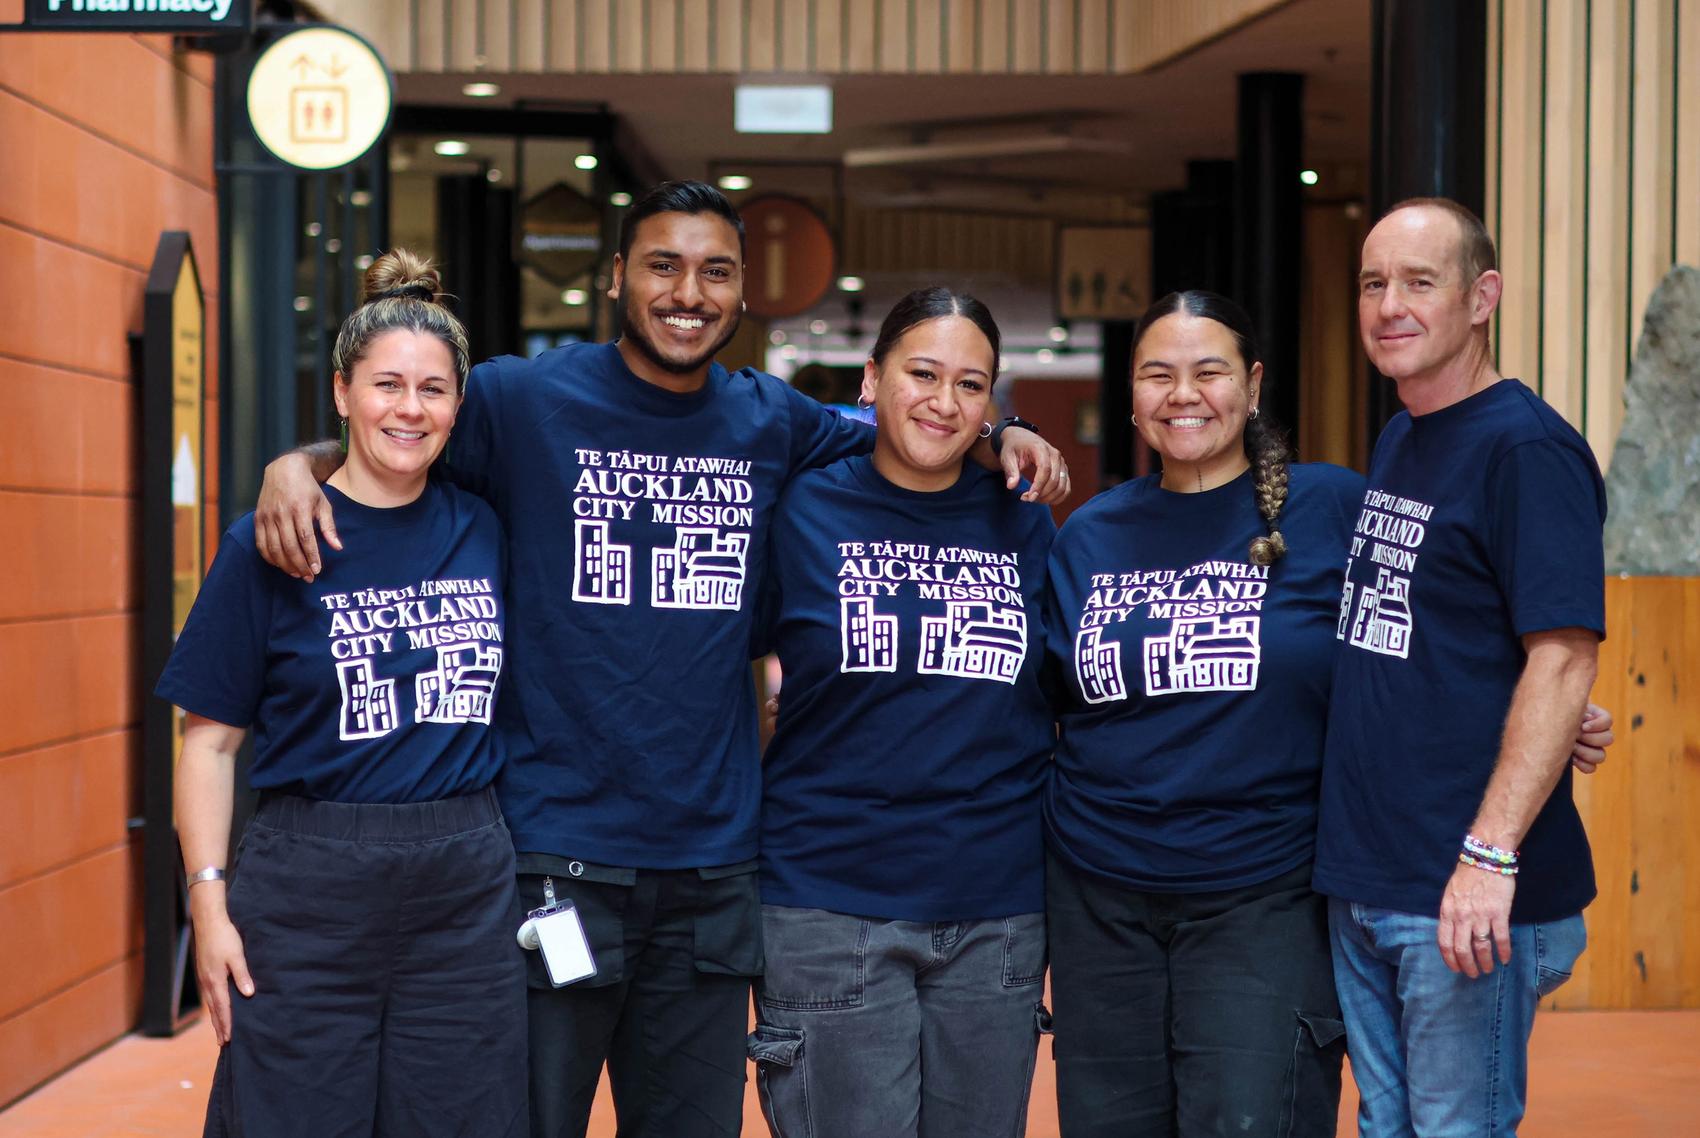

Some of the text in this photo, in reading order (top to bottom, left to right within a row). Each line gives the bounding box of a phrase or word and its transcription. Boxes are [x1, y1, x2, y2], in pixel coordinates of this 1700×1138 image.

[575, 449, 752, 476] TE TĀPUI ATAWHAI
[573, 469, 752, 504] AUCKLAND
[573, 497, 752, 527] CITY MISSION
[838, 540, 1018, 566] TE TĀPUI ATAWHAI
[838, 559, 1021, 589] AUCKLAND
[1091, 560, 1271, 588] TE TĀPUI ATAWHAI
[321, 579, 492, 609] TE TĀPUI ATAWHAI
[838, 579, 1024, 608] CITY MISSION
[1083, 578, 1267, 611] AUCKLAND
[328, 595, 497, 637] AUCKLAND
[1080, 600, 1264, 629] CITY MISSION
[331, 621, 502, 659] CITY MISSION
